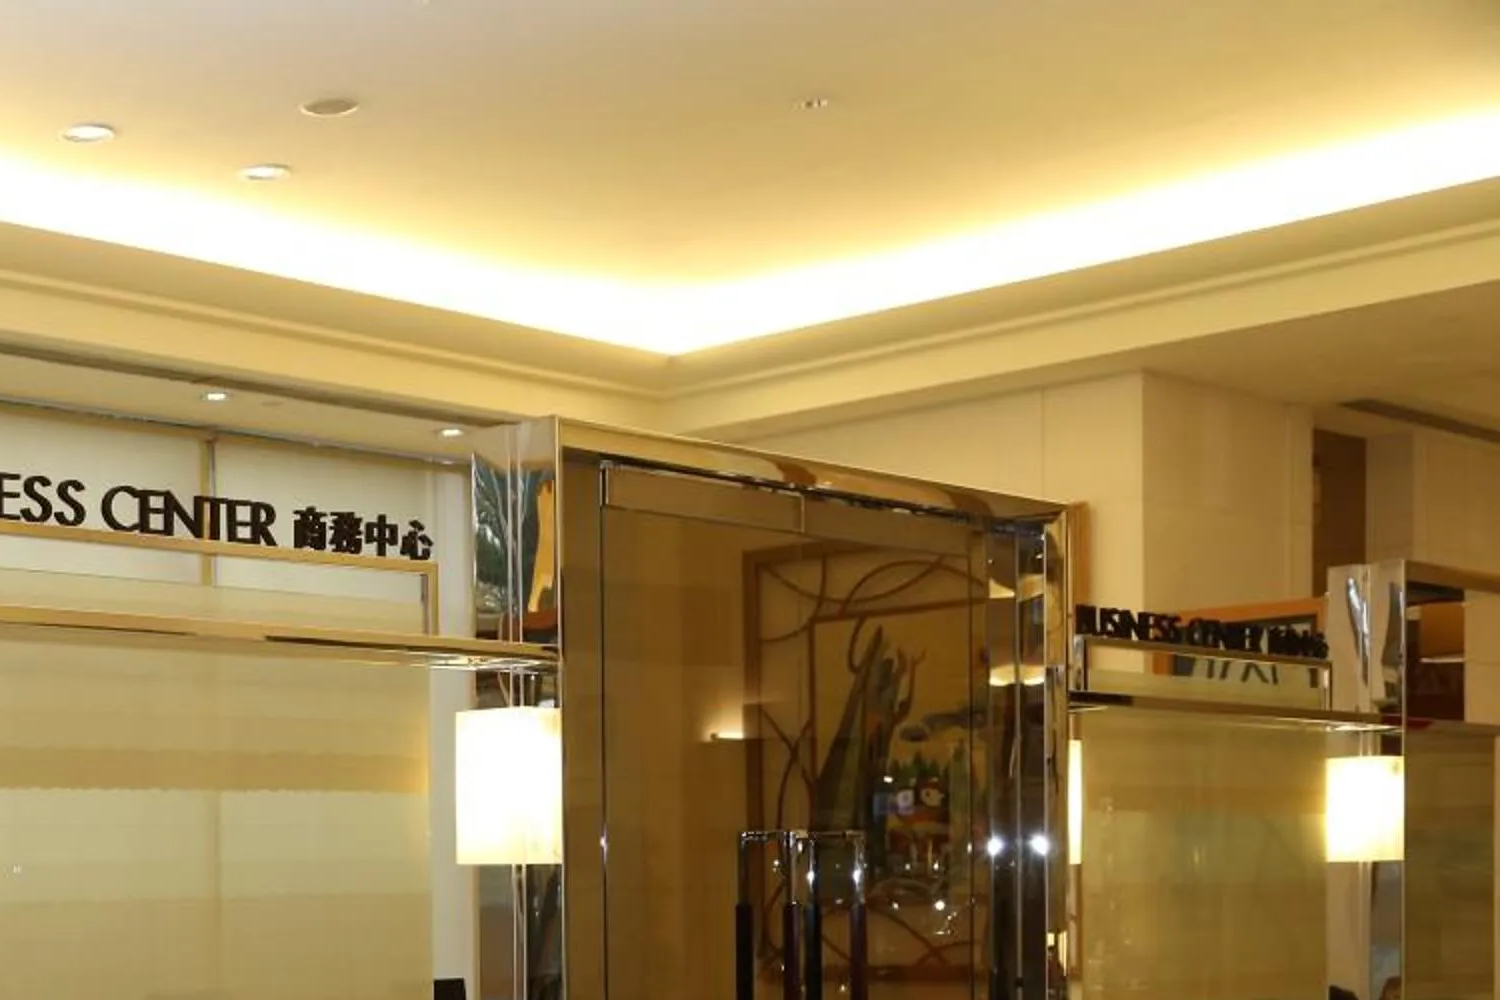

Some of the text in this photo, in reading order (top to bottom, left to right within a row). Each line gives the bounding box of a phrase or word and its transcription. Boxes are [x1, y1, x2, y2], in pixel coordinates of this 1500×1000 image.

[100, 484, 277, 547] CENTER
[293, 505, 434, 561] 商務中心
